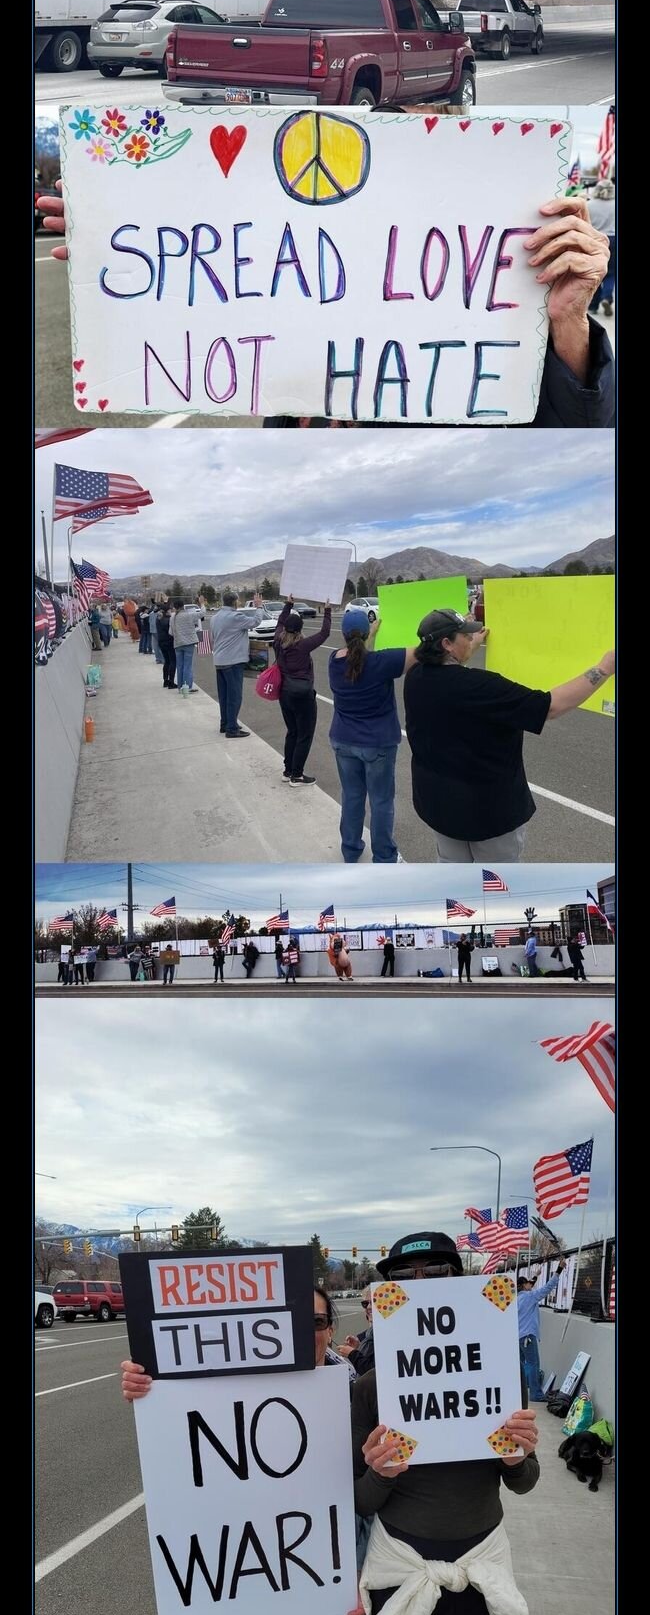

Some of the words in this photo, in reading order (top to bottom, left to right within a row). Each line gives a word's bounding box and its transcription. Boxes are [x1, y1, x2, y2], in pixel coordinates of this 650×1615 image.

[100, 220, 346, 307] SPREAD
[383, 224, 540, 312] LOVE
[144, 330, 276, 416] NOT
[324, 336, 521, 420] HATE
[156, 1261, 279, 1306] RESIST
[159, 1317, 284, 1367] THIS
[416, 1305, 456, 1337] NO
[397, 1342, 482, 1380] MORE
[398, 1387, 502, 1423] WARS!!
[187, 1396, 309, 1488] NO
[156, 1504, 342, 1608] WAR!
